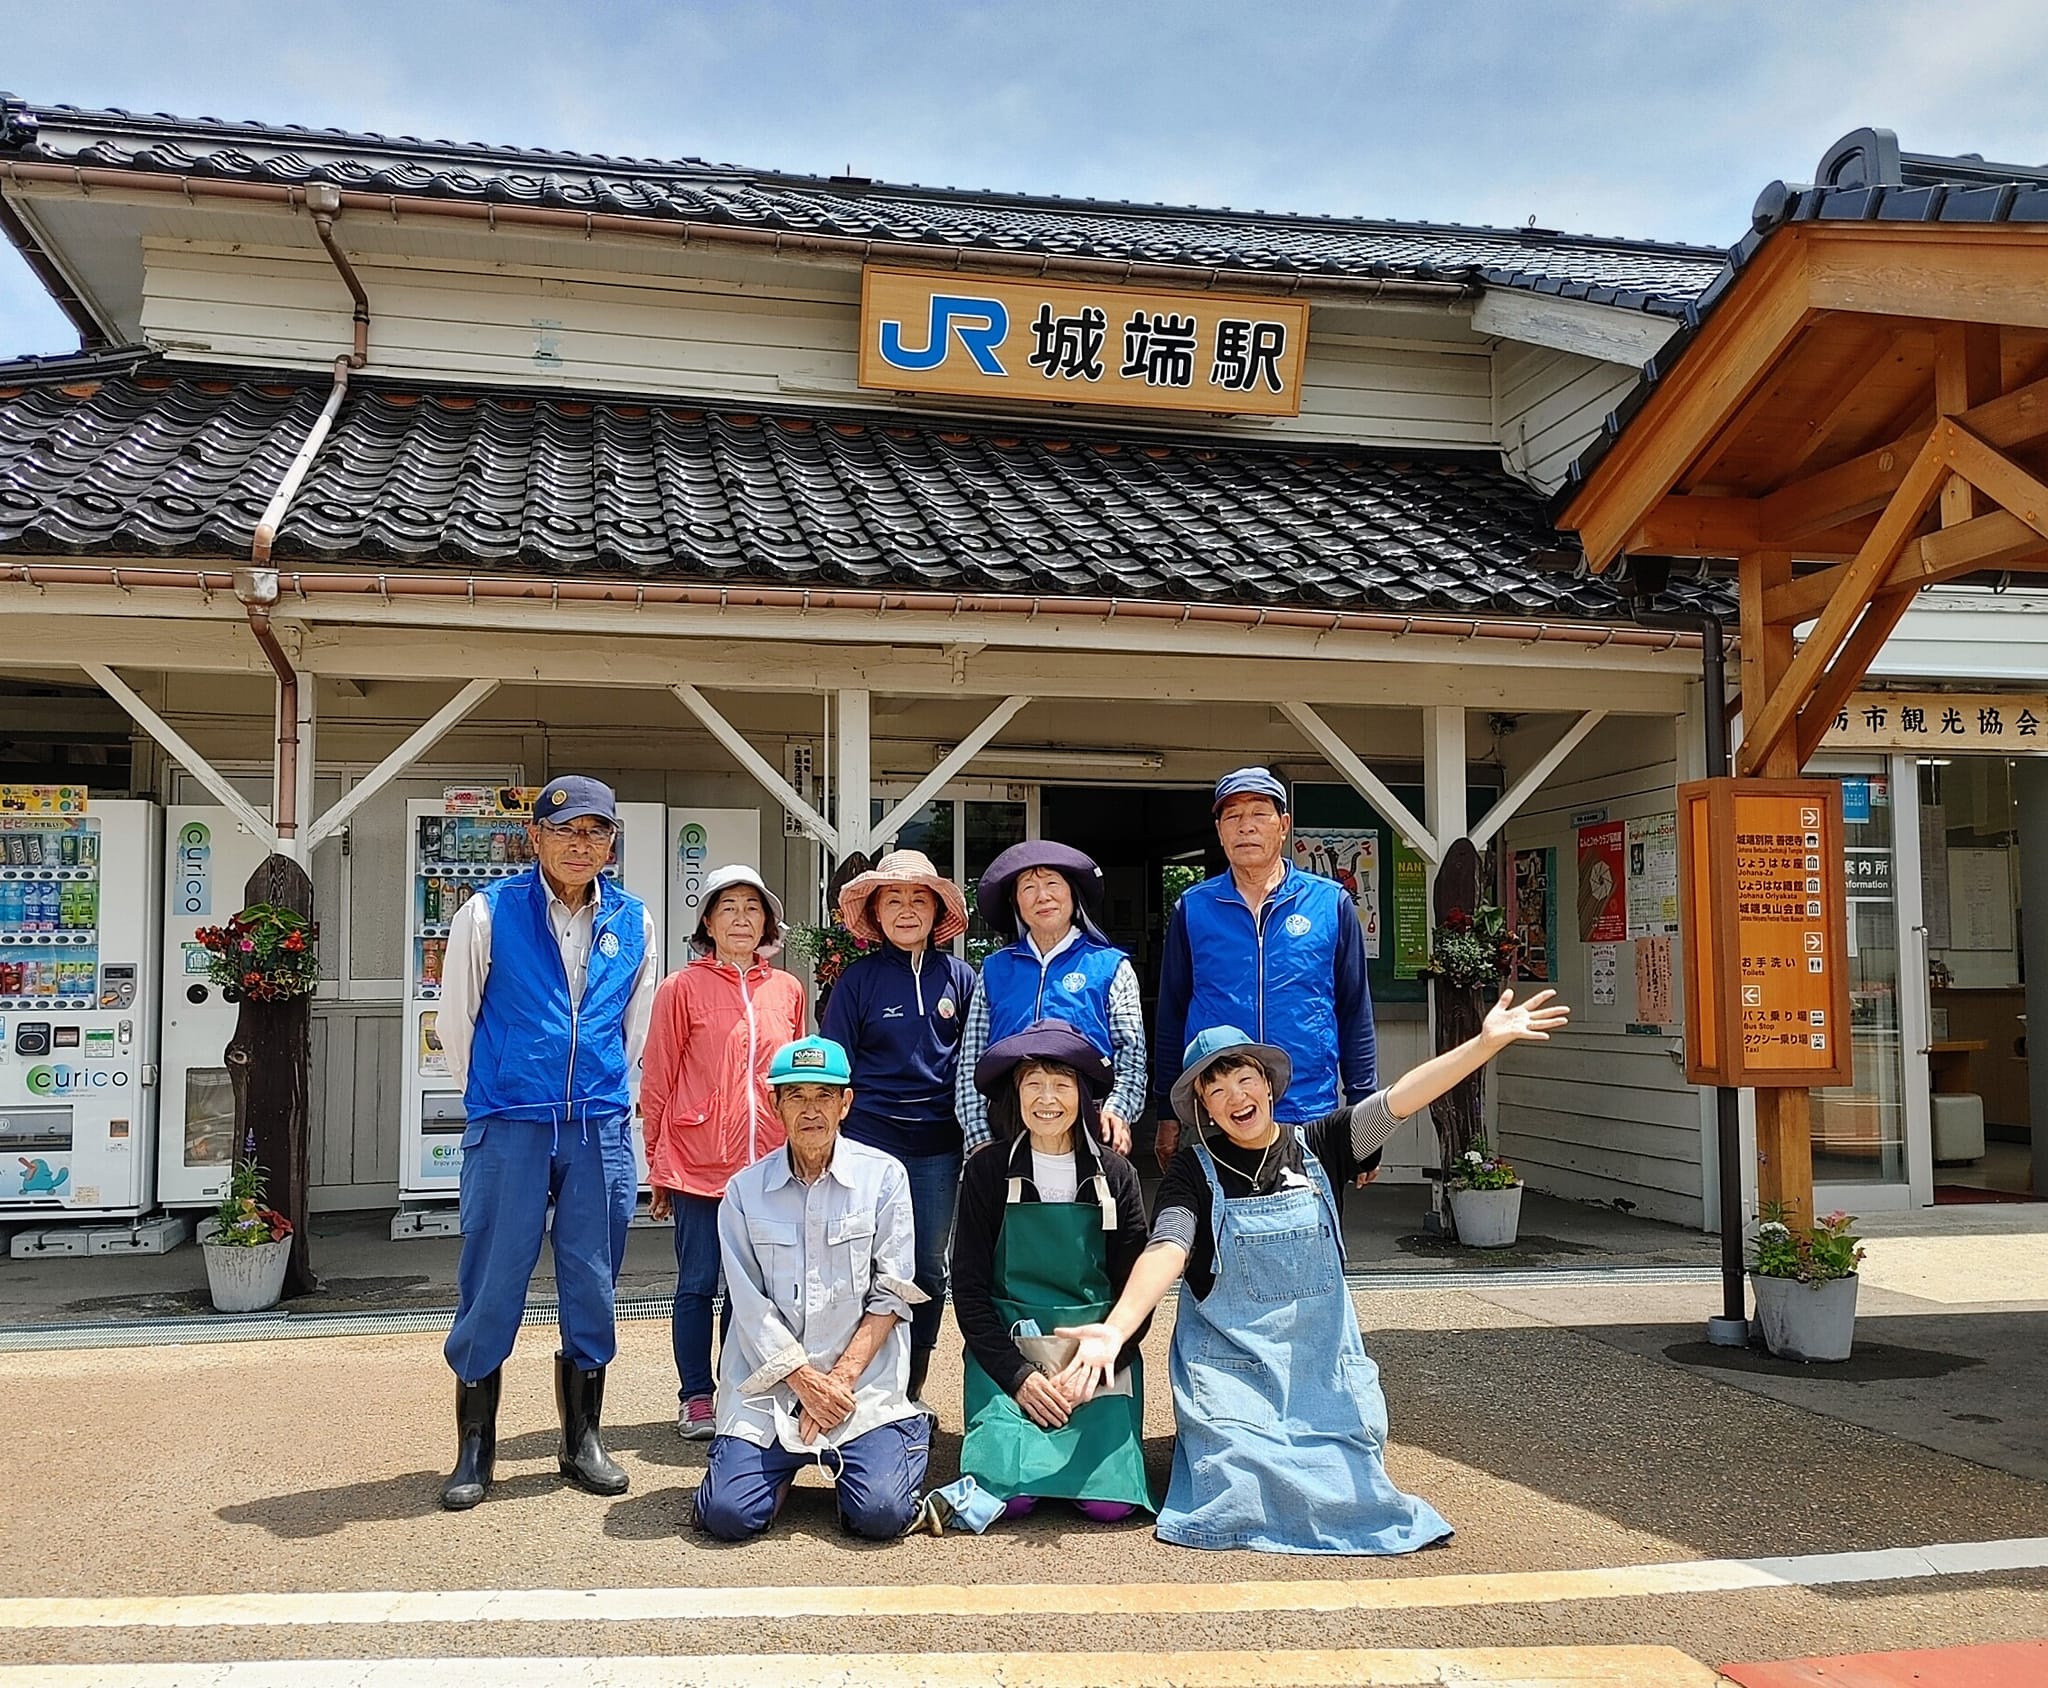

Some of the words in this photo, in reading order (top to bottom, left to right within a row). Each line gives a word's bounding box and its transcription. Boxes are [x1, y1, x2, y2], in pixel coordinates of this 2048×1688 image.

[879, 294, 1009, 377] JR
[1028, 302, 1286, 393] 城端駅
[685, 830, 704, 908] curico
[1398, 862, 1426, 872] NAN
[1737, 858, 1803, 869] じょうはな座
[185, 829, 206, 913] curico
[1738, 880, 1803, 891] じょうはな織館
[1845, 880, 1888, 889] nformation
[1739, 903, 1804, 915] 城端曳山会館
[1742, 957, 1795, 968] お手洗い
[1743, 1011, 1807, 1021] バス乗り場
[1759, 1023, 1775, 1031] Stop
[1744, 1034, 1808, 1044] タクシー乗り場
[35, 1068, 128, 1088] curico
[436, 1147, 462, 1156] curi
